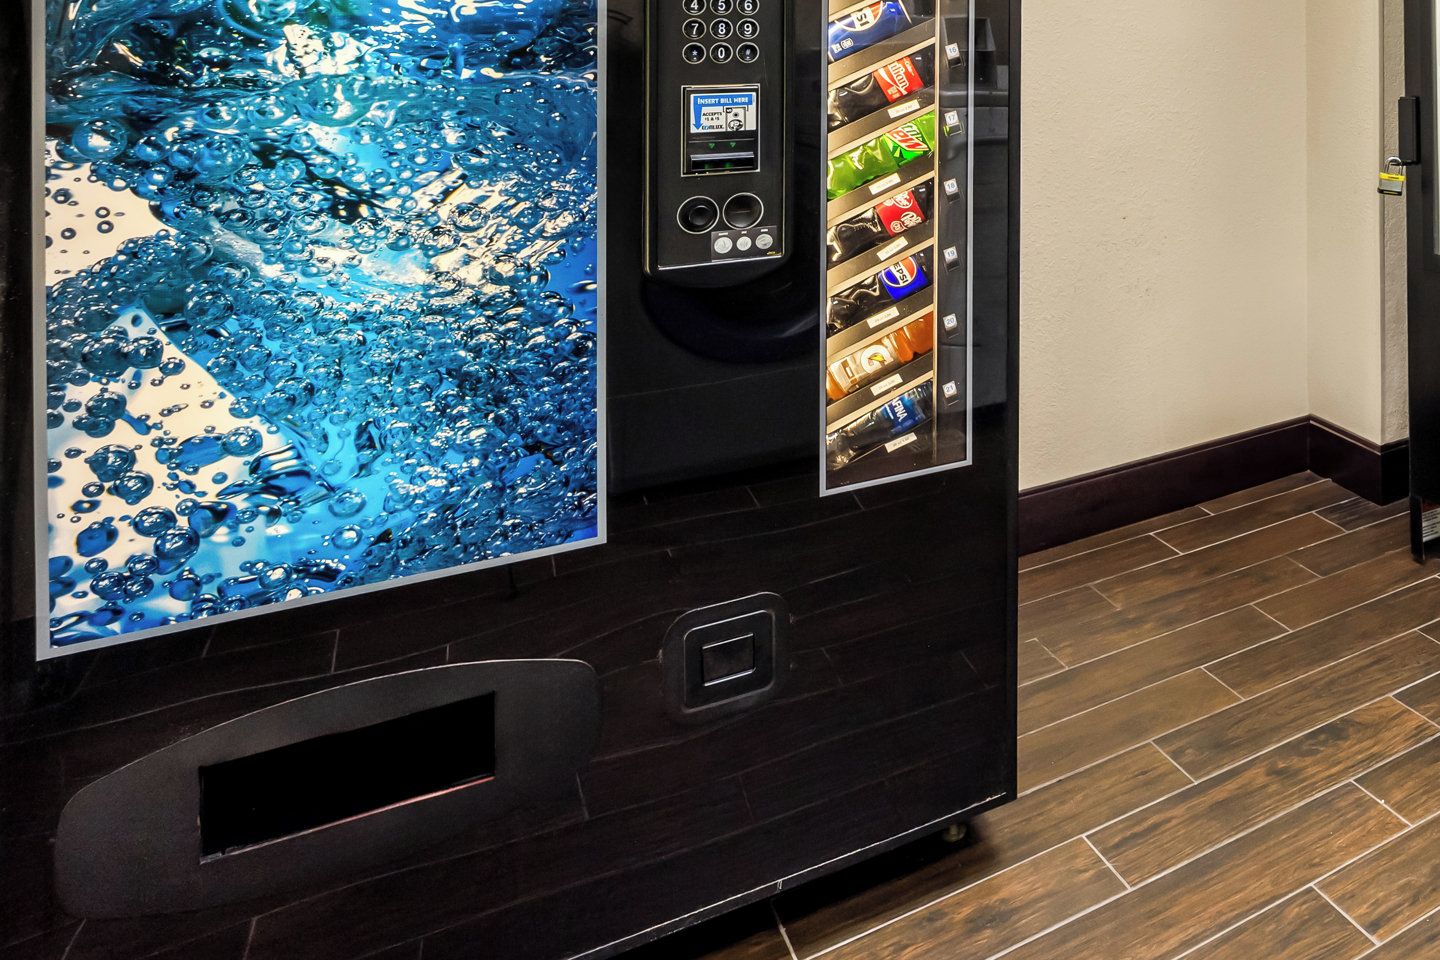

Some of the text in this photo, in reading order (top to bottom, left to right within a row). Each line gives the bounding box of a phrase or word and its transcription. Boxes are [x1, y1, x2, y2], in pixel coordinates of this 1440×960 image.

[717, 0, 726, 11] 5
[744, 0, 753, 11] 6
[691, 22, 752, 35] 7 8 9
